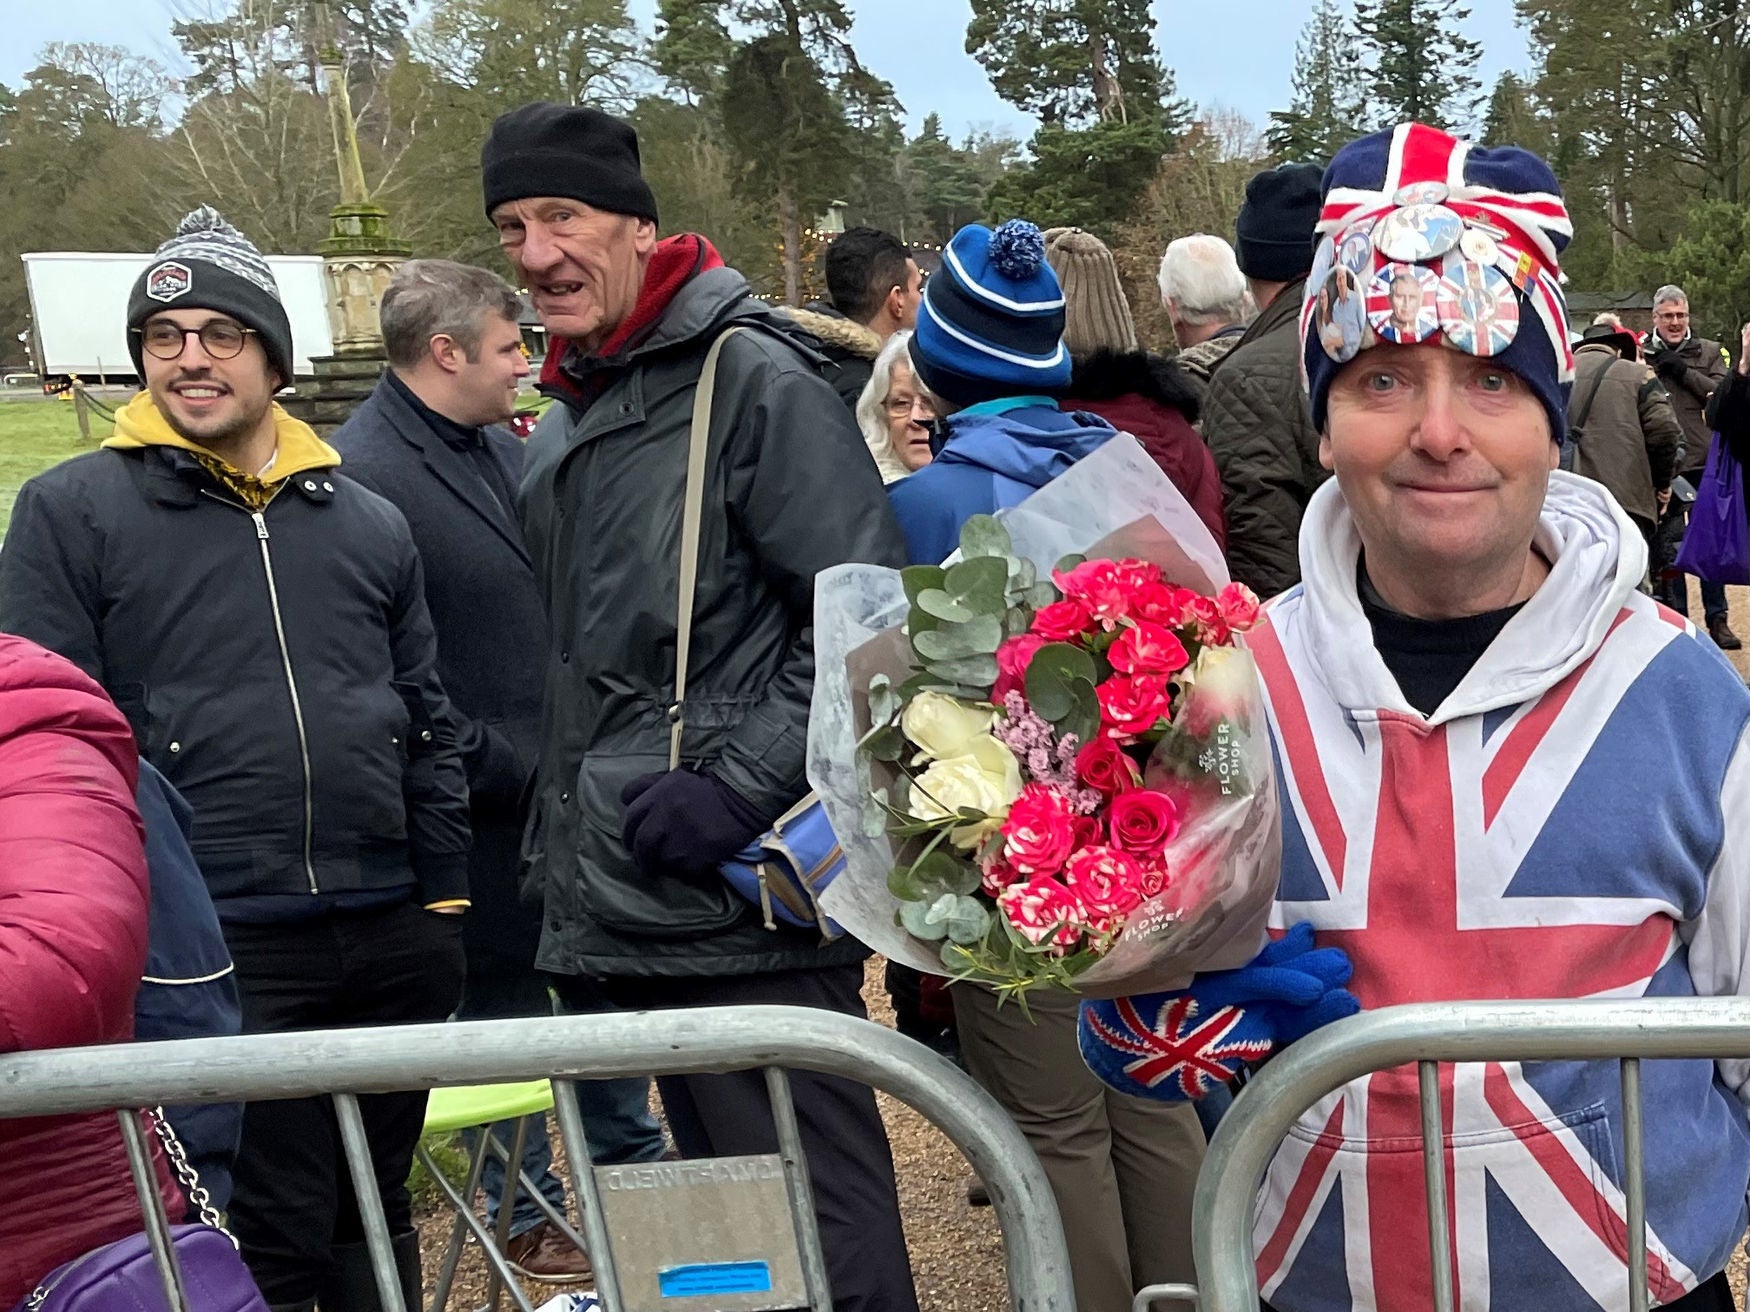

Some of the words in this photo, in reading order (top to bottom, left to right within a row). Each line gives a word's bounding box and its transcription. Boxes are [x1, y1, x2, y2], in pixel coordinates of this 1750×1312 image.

[1217, 723, 1232, 795] FLOWER
[1230, 740, 1241, 776] SHOP
[1137, 922, 1169, 942] SHOP
